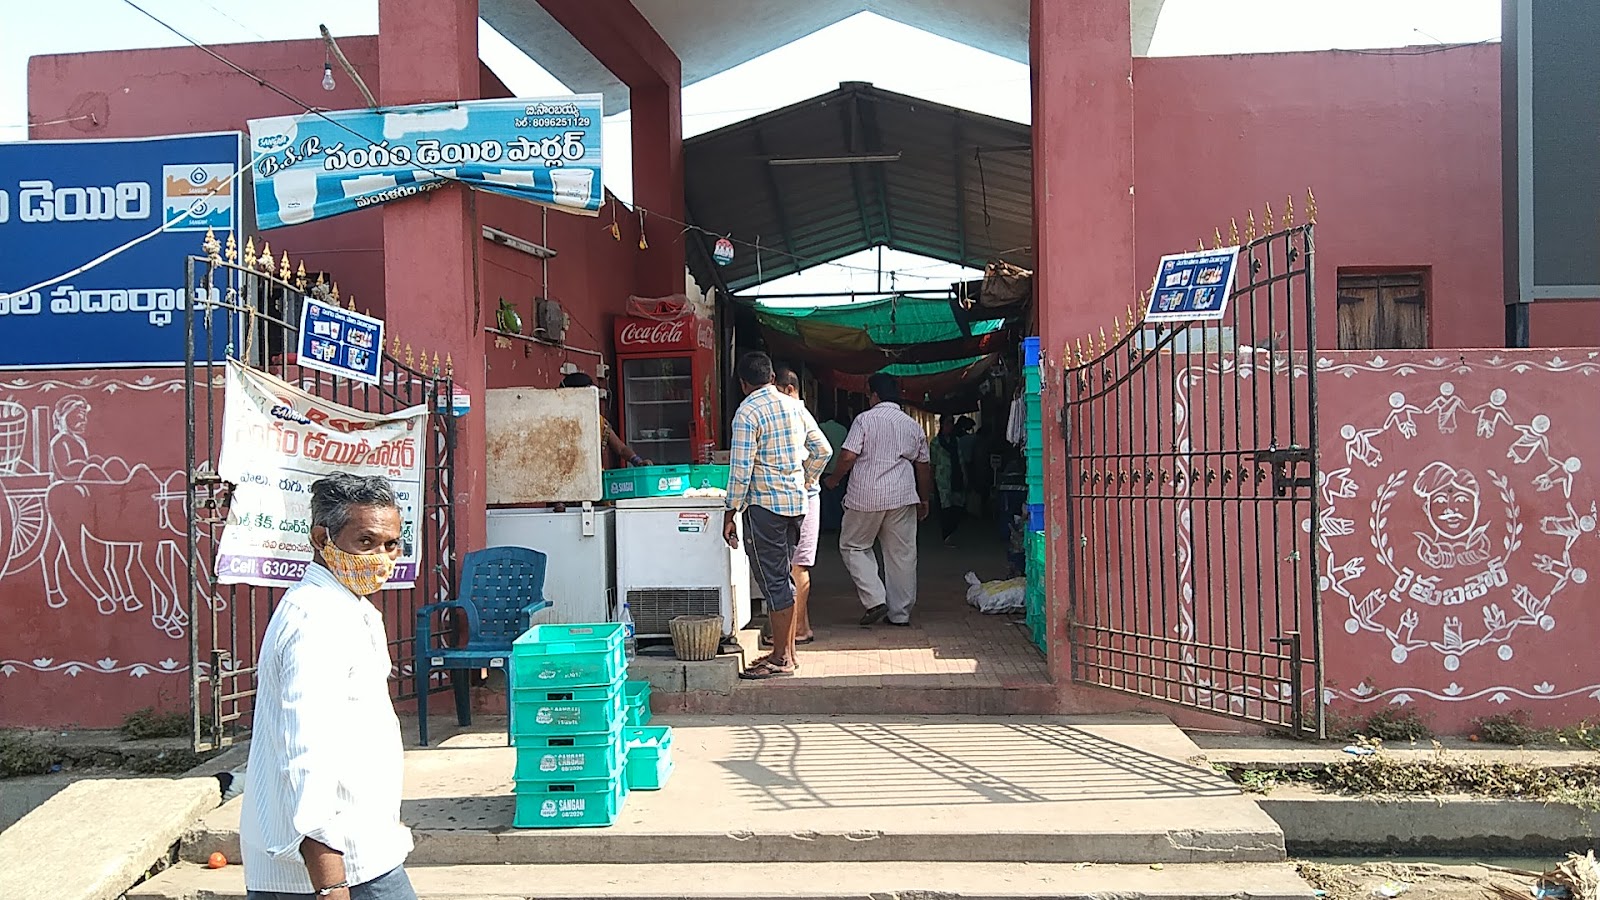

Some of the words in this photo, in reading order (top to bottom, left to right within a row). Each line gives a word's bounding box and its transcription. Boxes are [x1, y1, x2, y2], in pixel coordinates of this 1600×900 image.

[532, 116, 590, 128] 8096251129
[258, 136, 323, 177] B.S.R
[324, 143, 411, 171] సంగం
[507, 130, 585, 168] పార్లర్
[620, 320, 686, 345] Coca-Cola
[261, 559, 307, 579] 63025
